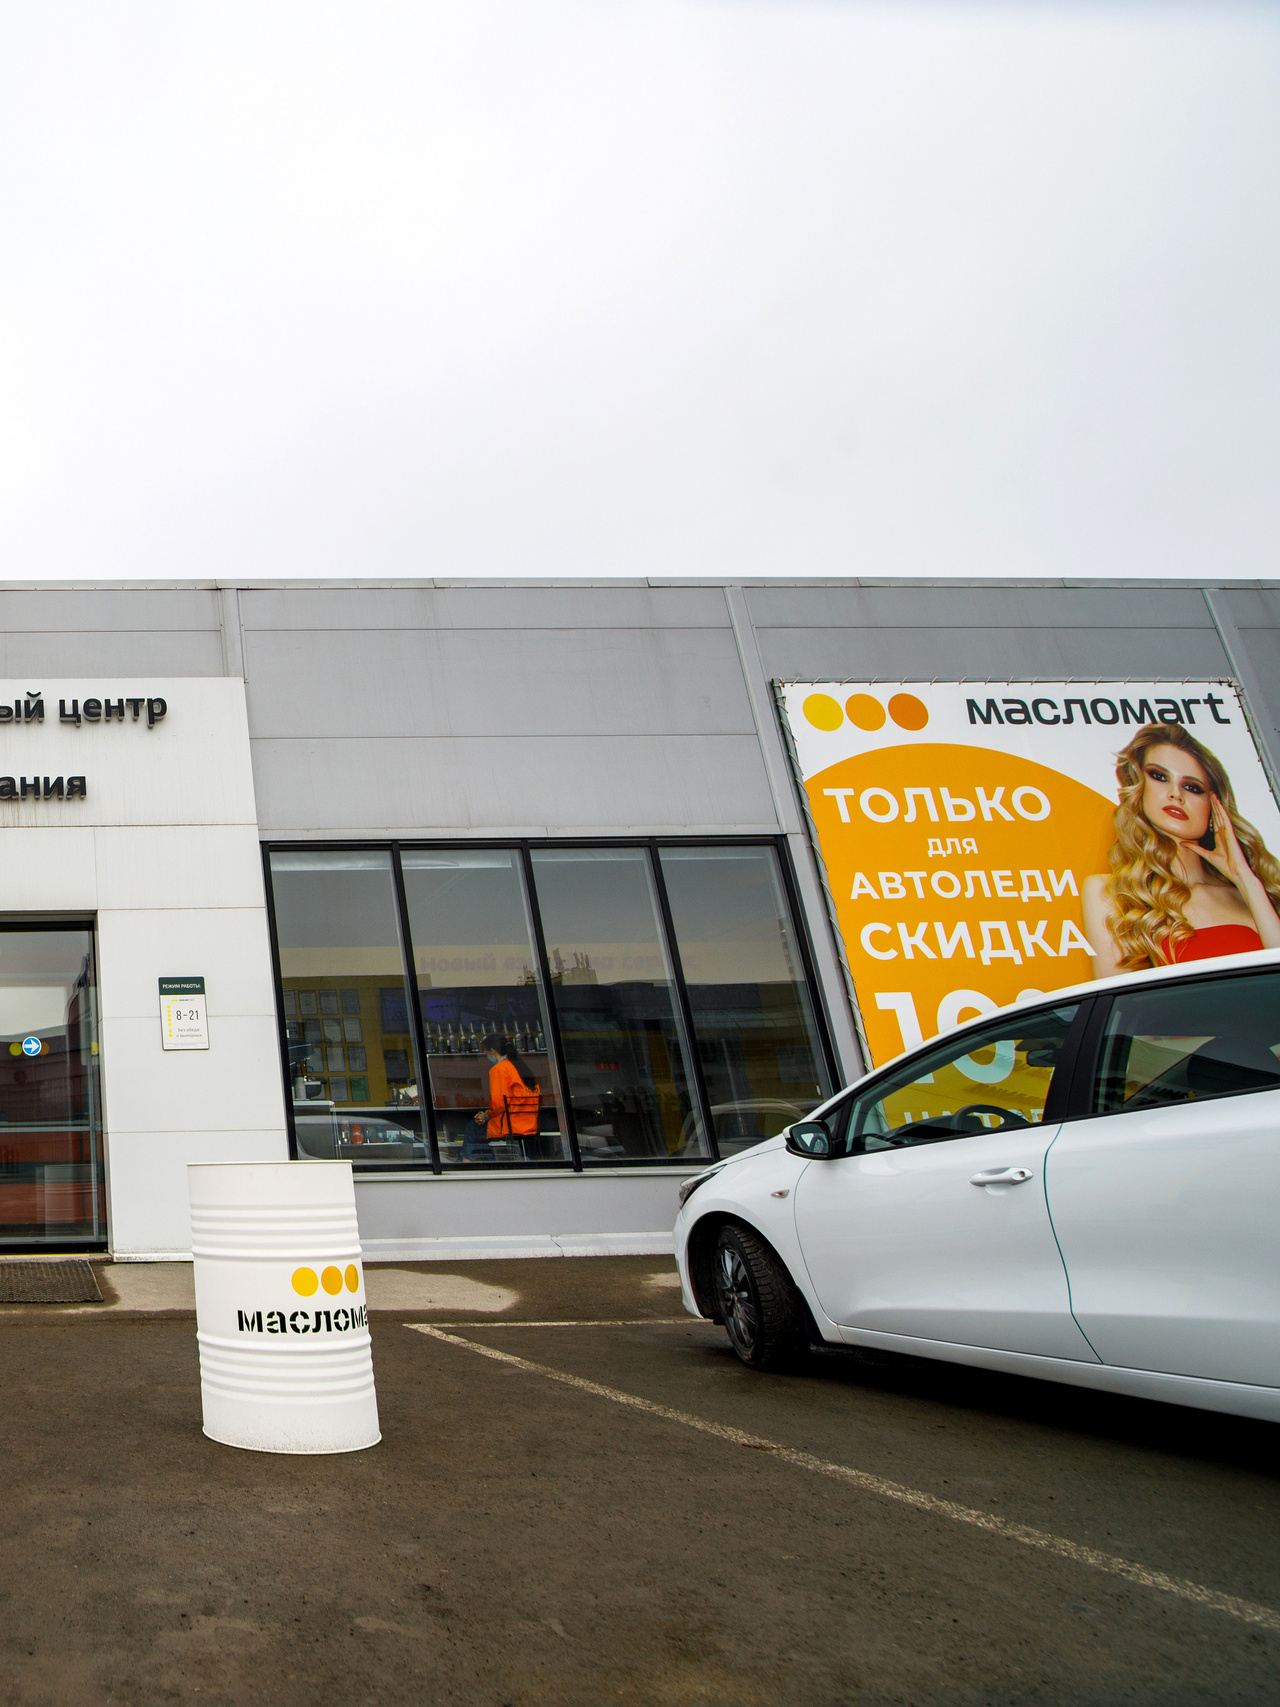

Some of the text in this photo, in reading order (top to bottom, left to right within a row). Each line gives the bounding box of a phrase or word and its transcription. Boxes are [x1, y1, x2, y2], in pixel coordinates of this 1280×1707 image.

[59, 696, 168, 727] центр
[823, 786, 1051, 823] ТОЛЬКО
[850, 869, 1080, 903] АВТОЛЕДИ
[860, 920, 1097, 965] СКИДКА
[176, 1010, 199, 1020] 8-21
